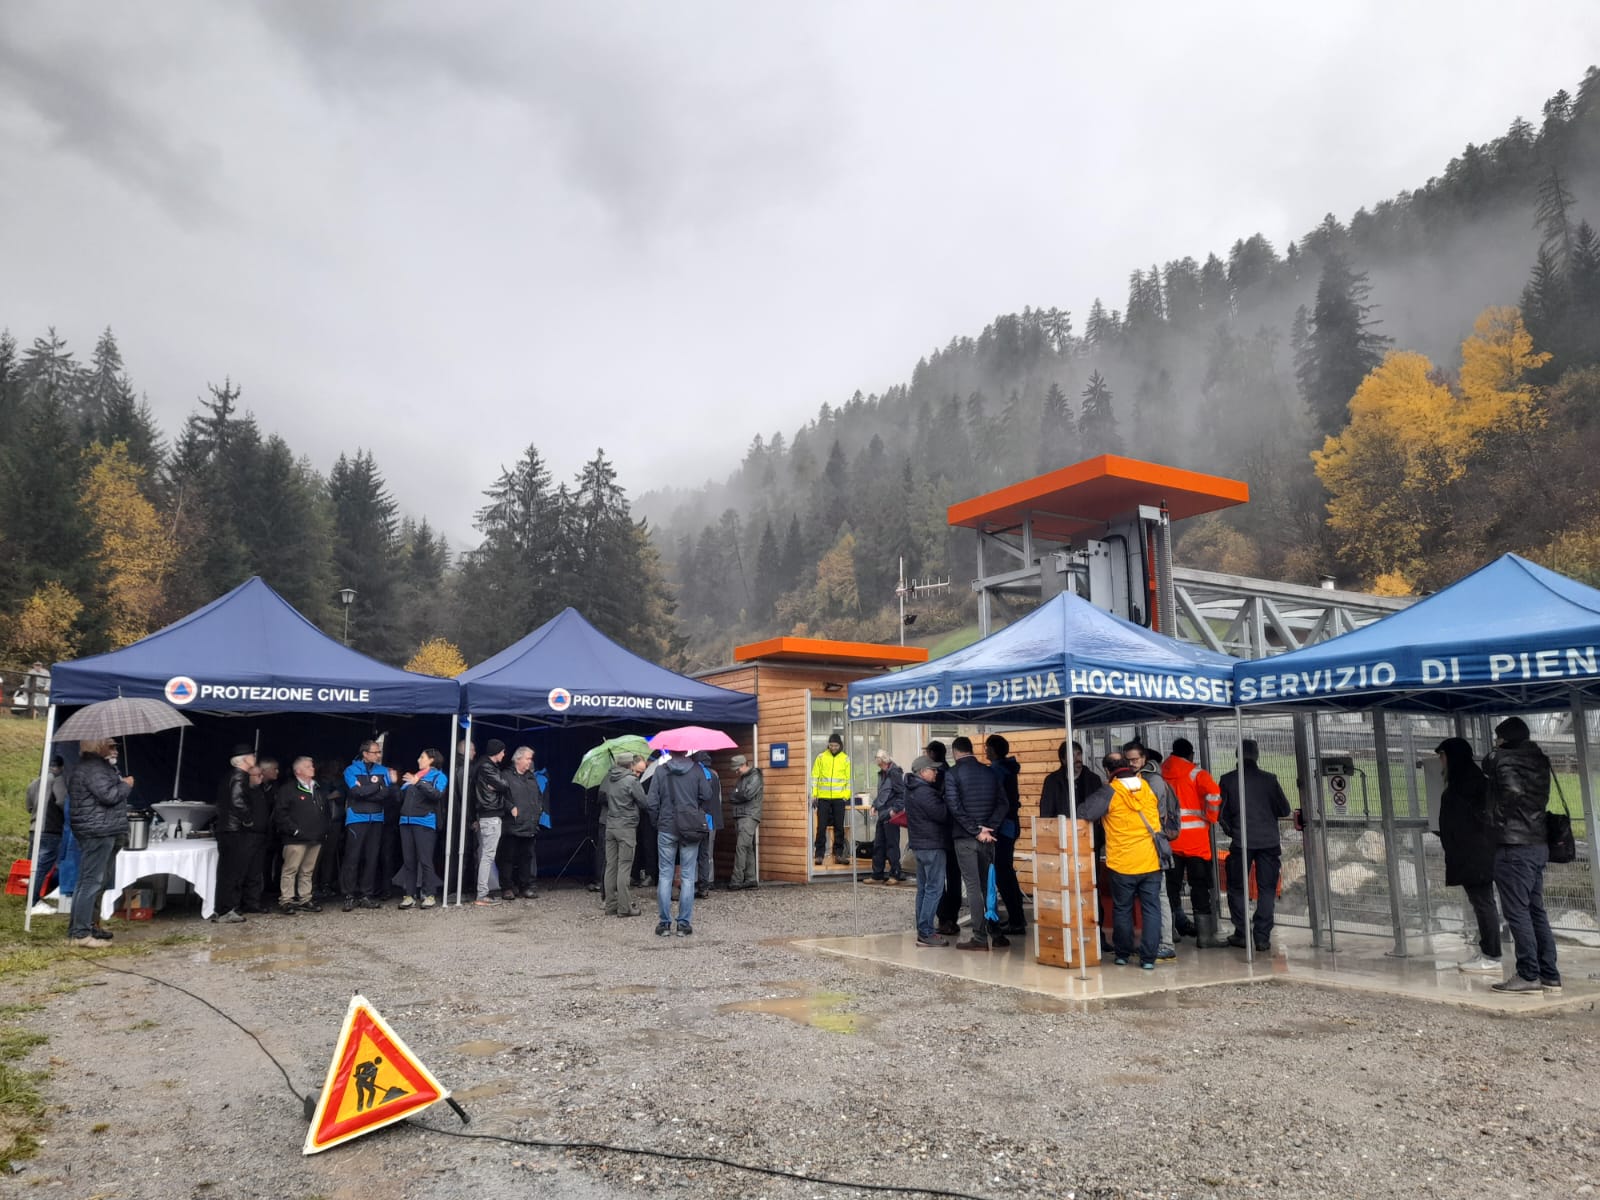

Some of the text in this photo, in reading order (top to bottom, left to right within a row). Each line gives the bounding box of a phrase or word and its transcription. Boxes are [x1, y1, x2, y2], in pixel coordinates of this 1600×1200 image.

[1239, 646, 1598, 702] SERVIZIO DI PIEN
[200, 685, 370, 702] PROTEZIONE CIVILE
[573, 694, 694, 712] PROTEZIONE CIVILE
[850, 671, 1061, 717] SERVIZIO DI PIENA
